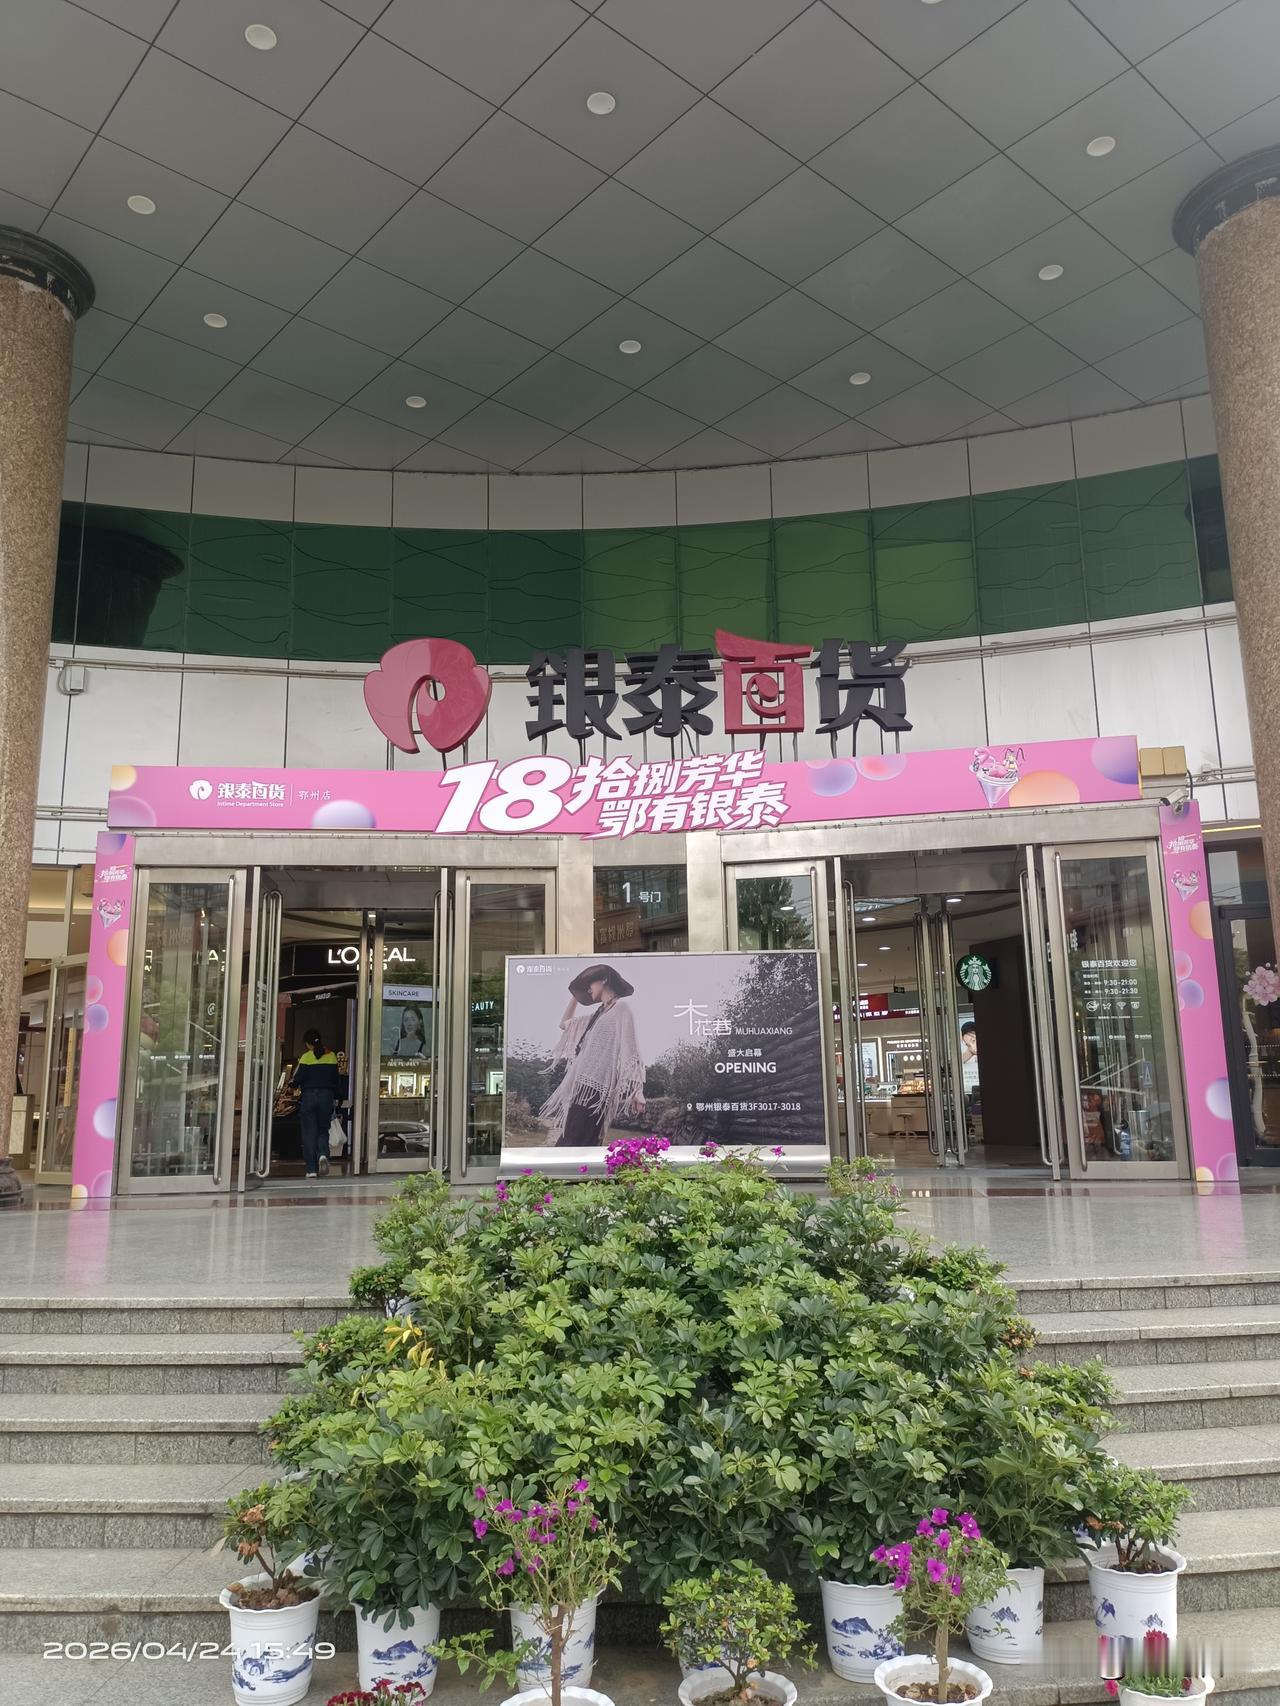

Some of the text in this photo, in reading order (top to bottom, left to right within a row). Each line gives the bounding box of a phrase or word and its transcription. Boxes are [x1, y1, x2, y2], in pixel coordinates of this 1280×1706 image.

[563, 749, 767, 814] 拾捌芳华
[298, 790, 332, 801] 鄂州店
[434, 755, 573, 834] 18
[236, 801, 269, 809] Department
[582, 781, 790, 840] 鄂有银泰
[327, 945, 416, 964] L'OAL
[388, 989, 419, 997] SKINCARE
[471, 1000, 494, 1012] EAUTY
[735, 1026, 793, 1036] MUHUAXIANG
[727, 1048, 762, 1058] 盛大启幕
[714, 1061, 777, 1074] OPENING
